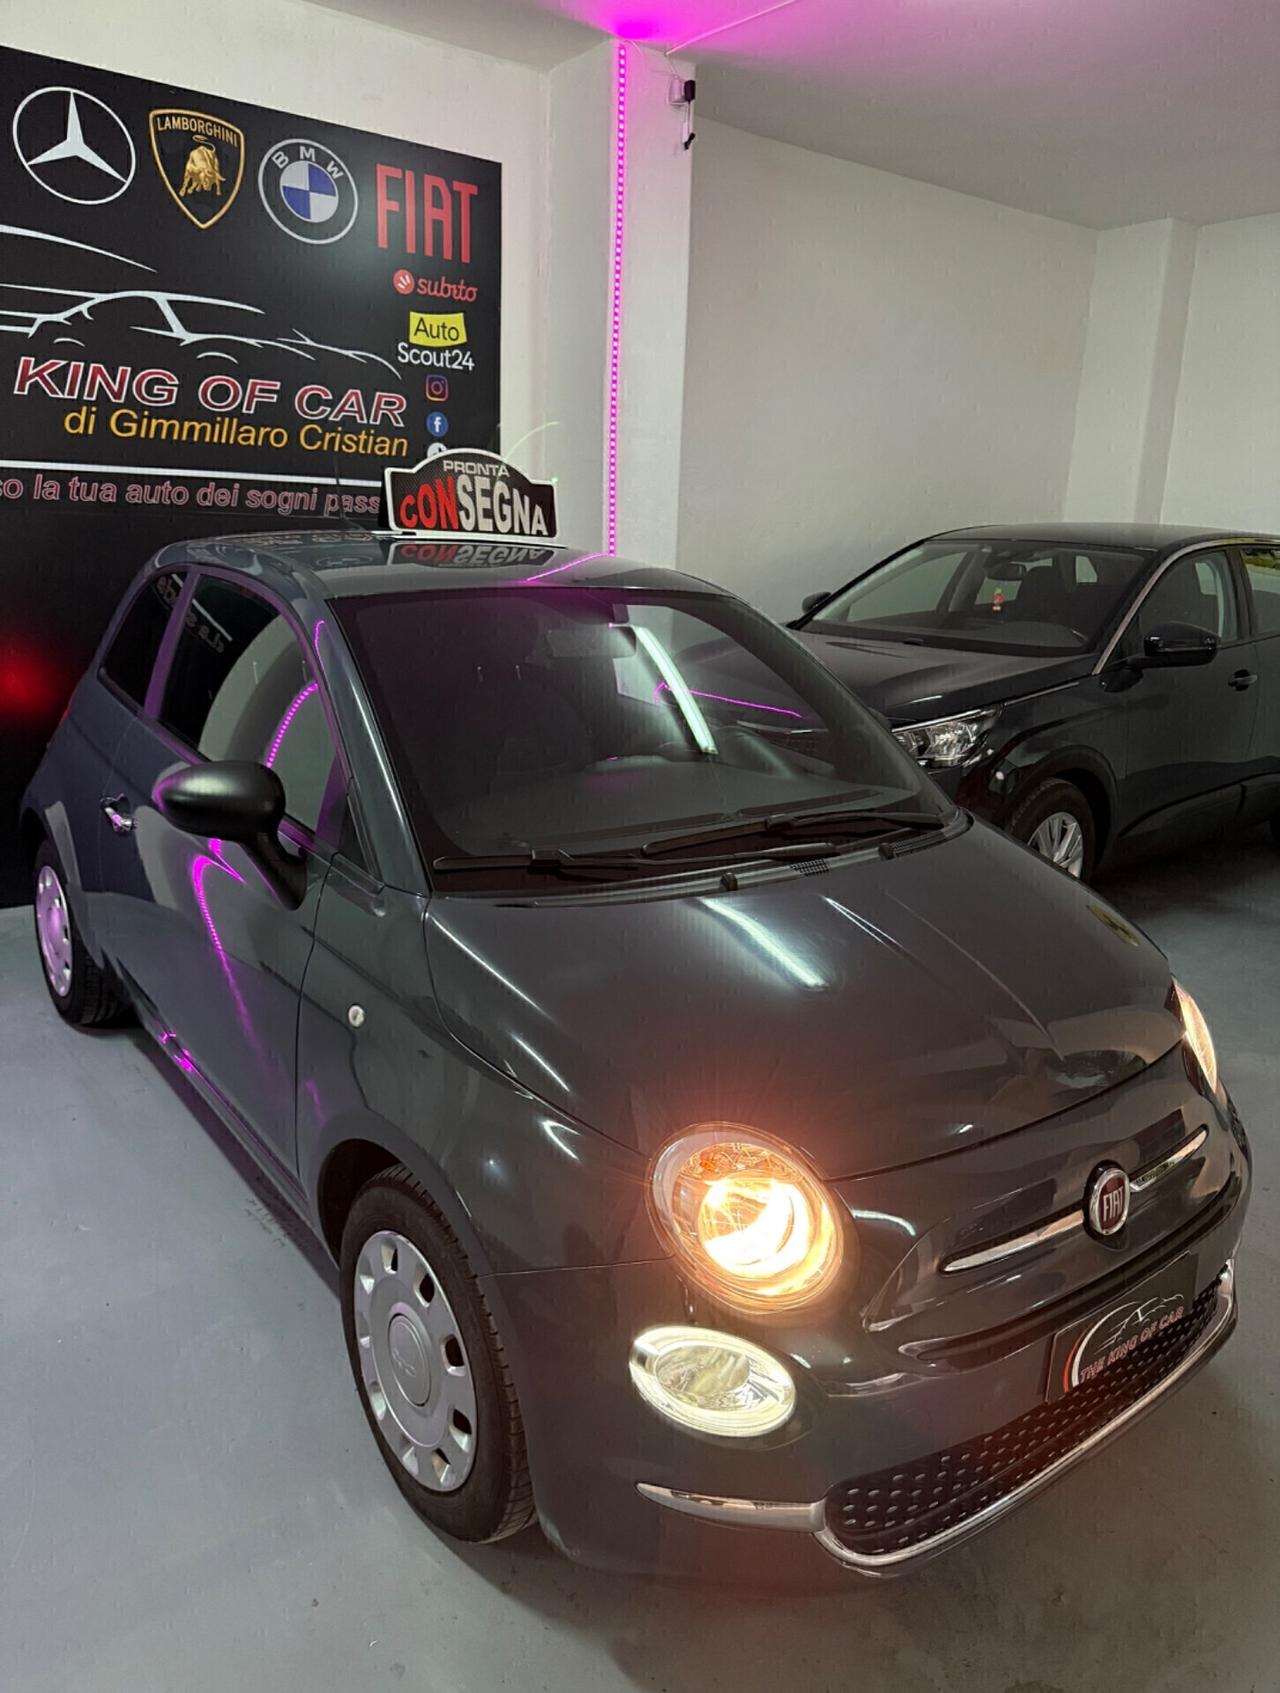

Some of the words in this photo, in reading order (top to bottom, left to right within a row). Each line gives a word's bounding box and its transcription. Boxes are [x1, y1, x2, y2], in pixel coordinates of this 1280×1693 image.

[156, 116, 238, 147] LAMBORGHINI
[271, 145, 344, 180] BMW
[376, 163, 478, 264] FIAT
[416, 276, 478, 302] subito
[413, 317, 460, 342] Auto
[397, 342, 475, 371] Scout24
[13, 356, 179, 406] KING
[198, 375, 281, 414] OF
[294, 384, 407, 427] CAR
[63, 405, 97, 435] di
[109, 408, 288, 449] Gimmillaro
[299, 423, 408, 457] Cristian
[443, 459, 511, 478] PRONTA
[33, 473, 60, 501] la
[68, 476, 118, 502] tua
[125, 481, 190, 505] auto
[196, 481, 240, 507] dei
[245, 487, 318, 516] sogni
[400, 474, 549, 536] CONSEGNA
[1103, 1185, 1124, 1222] FIAT
